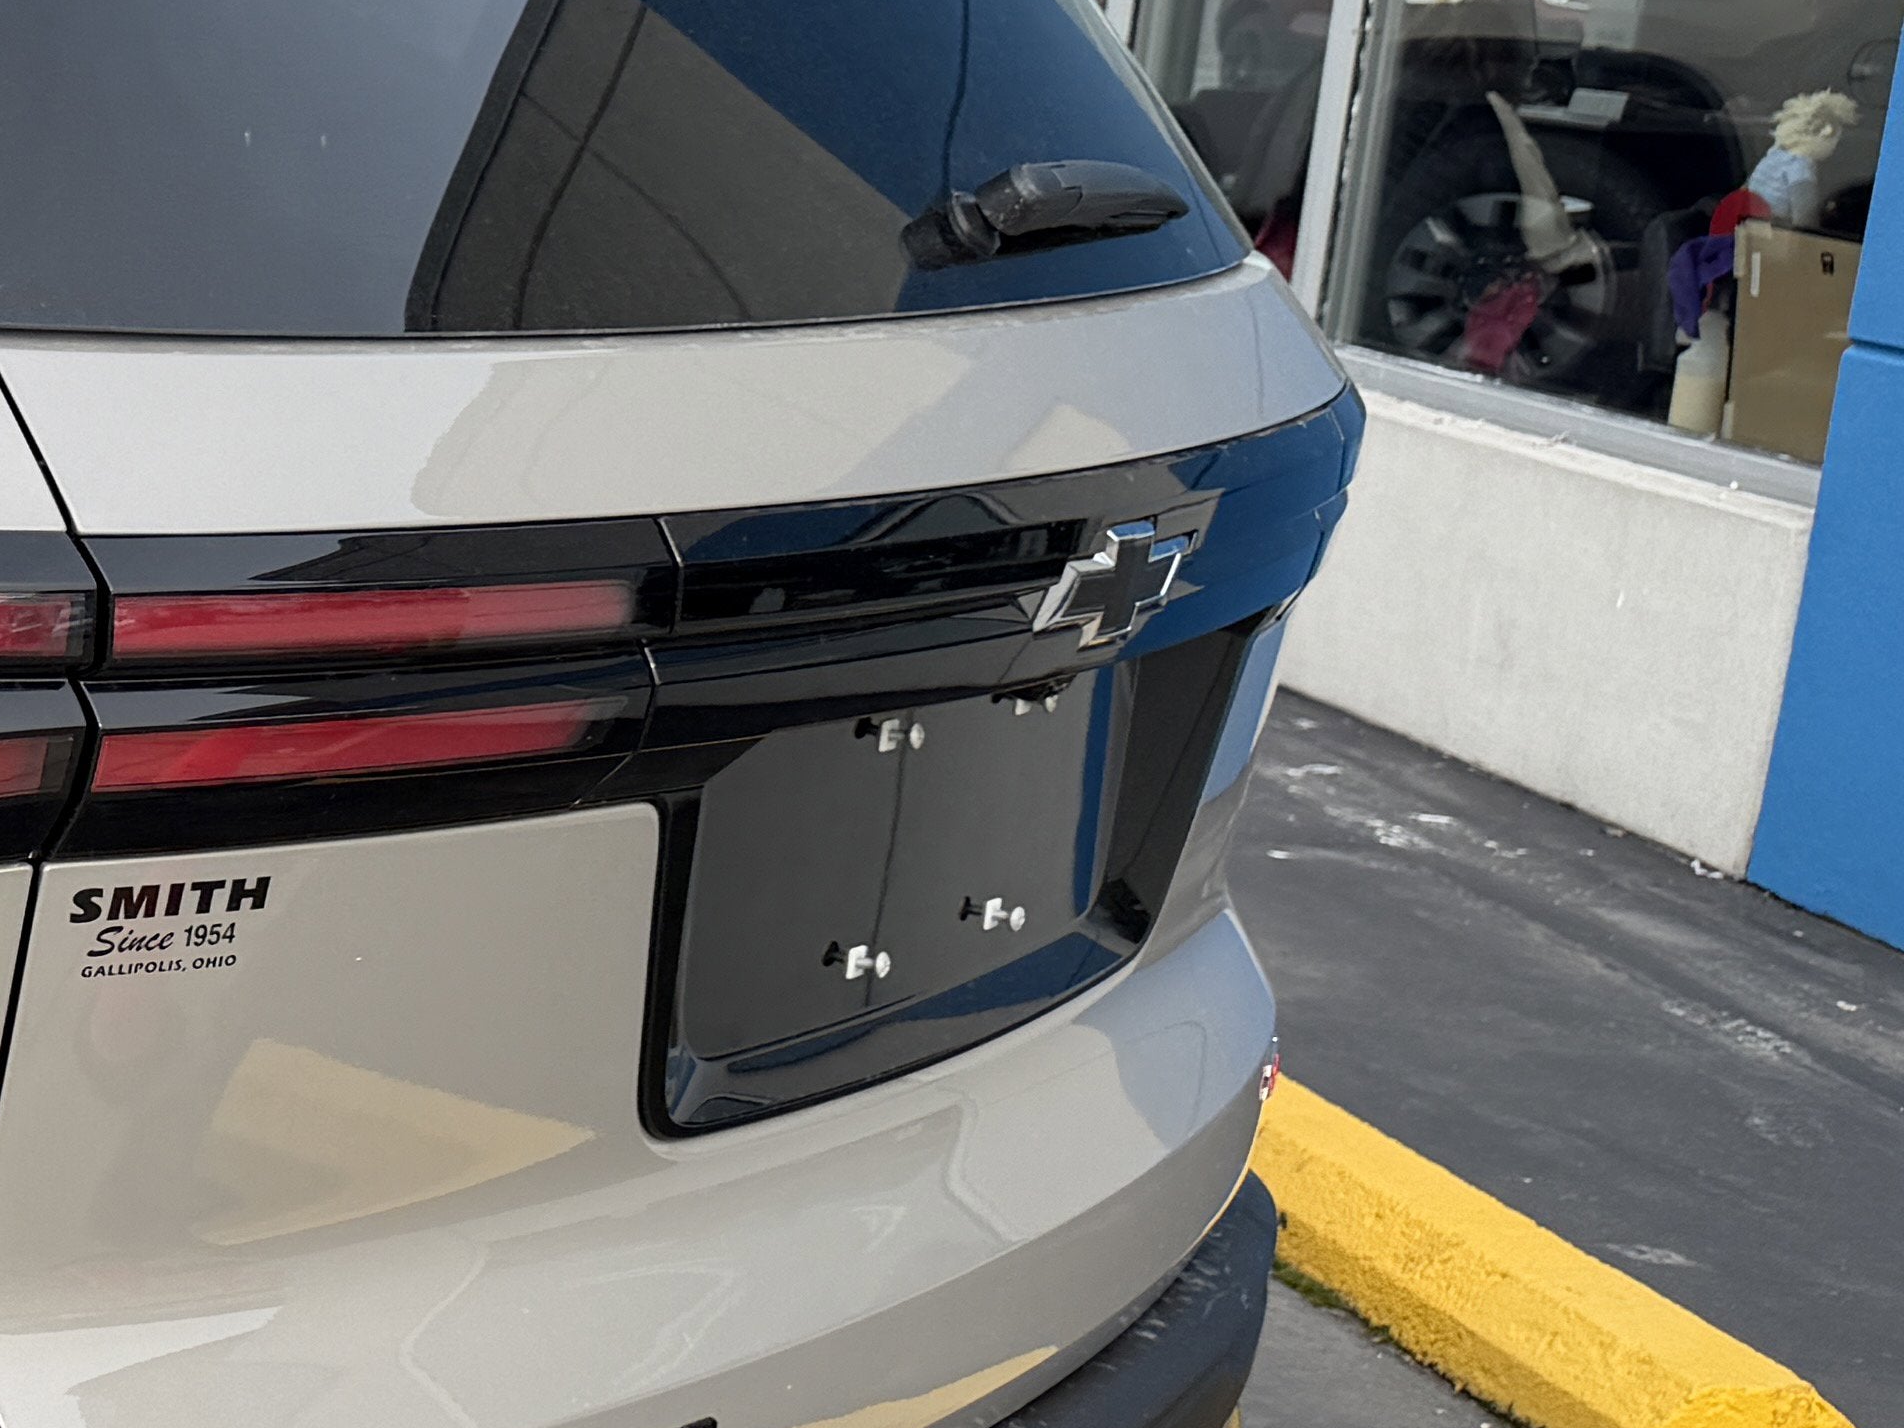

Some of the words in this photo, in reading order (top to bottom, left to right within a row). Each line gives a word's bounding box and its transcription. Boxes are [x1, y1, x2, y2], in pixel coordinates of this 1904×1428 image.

[69, 876, 272, 923] SMITH
[87, 925, 174, 958] Since
[183, 923, 236, 947] 1954
[81, 959, 187, 978] GALLIPOLIS,
[192, 954, 237, 969] OHIO
